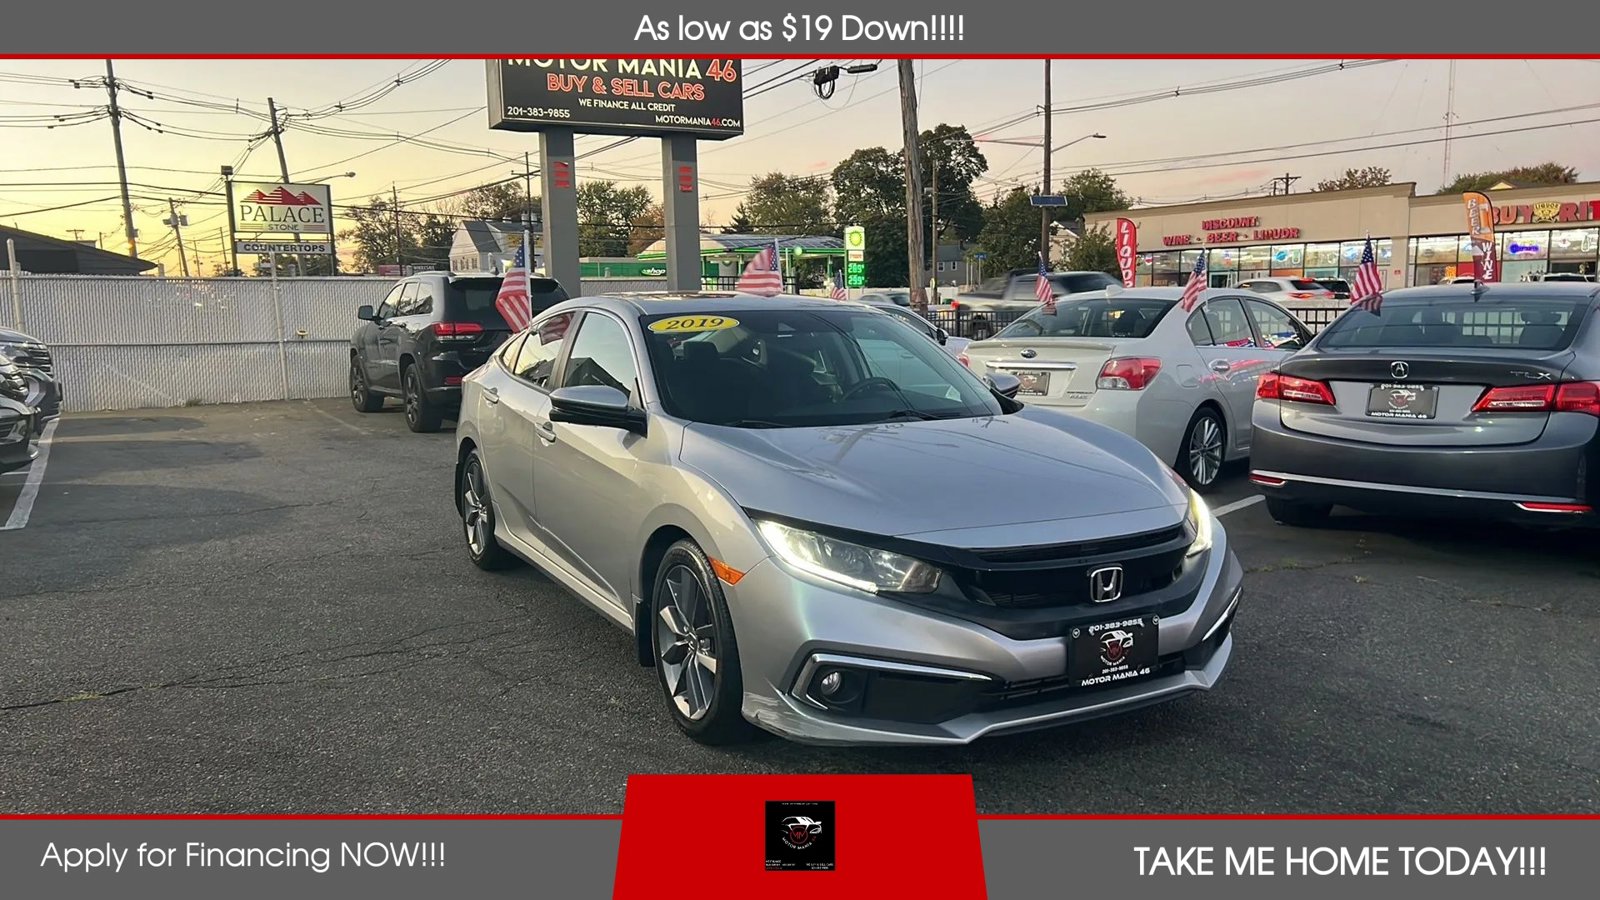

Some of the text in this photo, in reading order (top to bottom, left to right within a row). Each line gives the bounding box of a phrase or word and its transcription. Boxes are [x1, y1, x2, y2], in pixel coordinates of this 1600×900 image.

[618, 59, 702, 79] MANIA
[706, 59, 737, 82] 46
[547, 73, 705, 100] BUY & SELL CARS
[507, 106, 571, 118] 201-383-9855
[579, 98, 676, 112] WE FINANCE ALL CREDIT
[655, 115, 740, 127] MOTORMANIA46.COM
[240, 205, 325, 223] PALACE
[1467, 198, 1481, 236] BEER
[268, 223, 299, 231] STONE
[1202, 216, 1259, 231] DISCOUNT
[1163, 227, 1301, 247] WINE BEER LIQUOR
[243, 243, 326, 252] COUNTERTOPS
[1480, 242, 1494, 280] WINE
[665, 319, 725, 330] 2019
[1081, 667, 1151, 687] MOTOR MANIA 46
